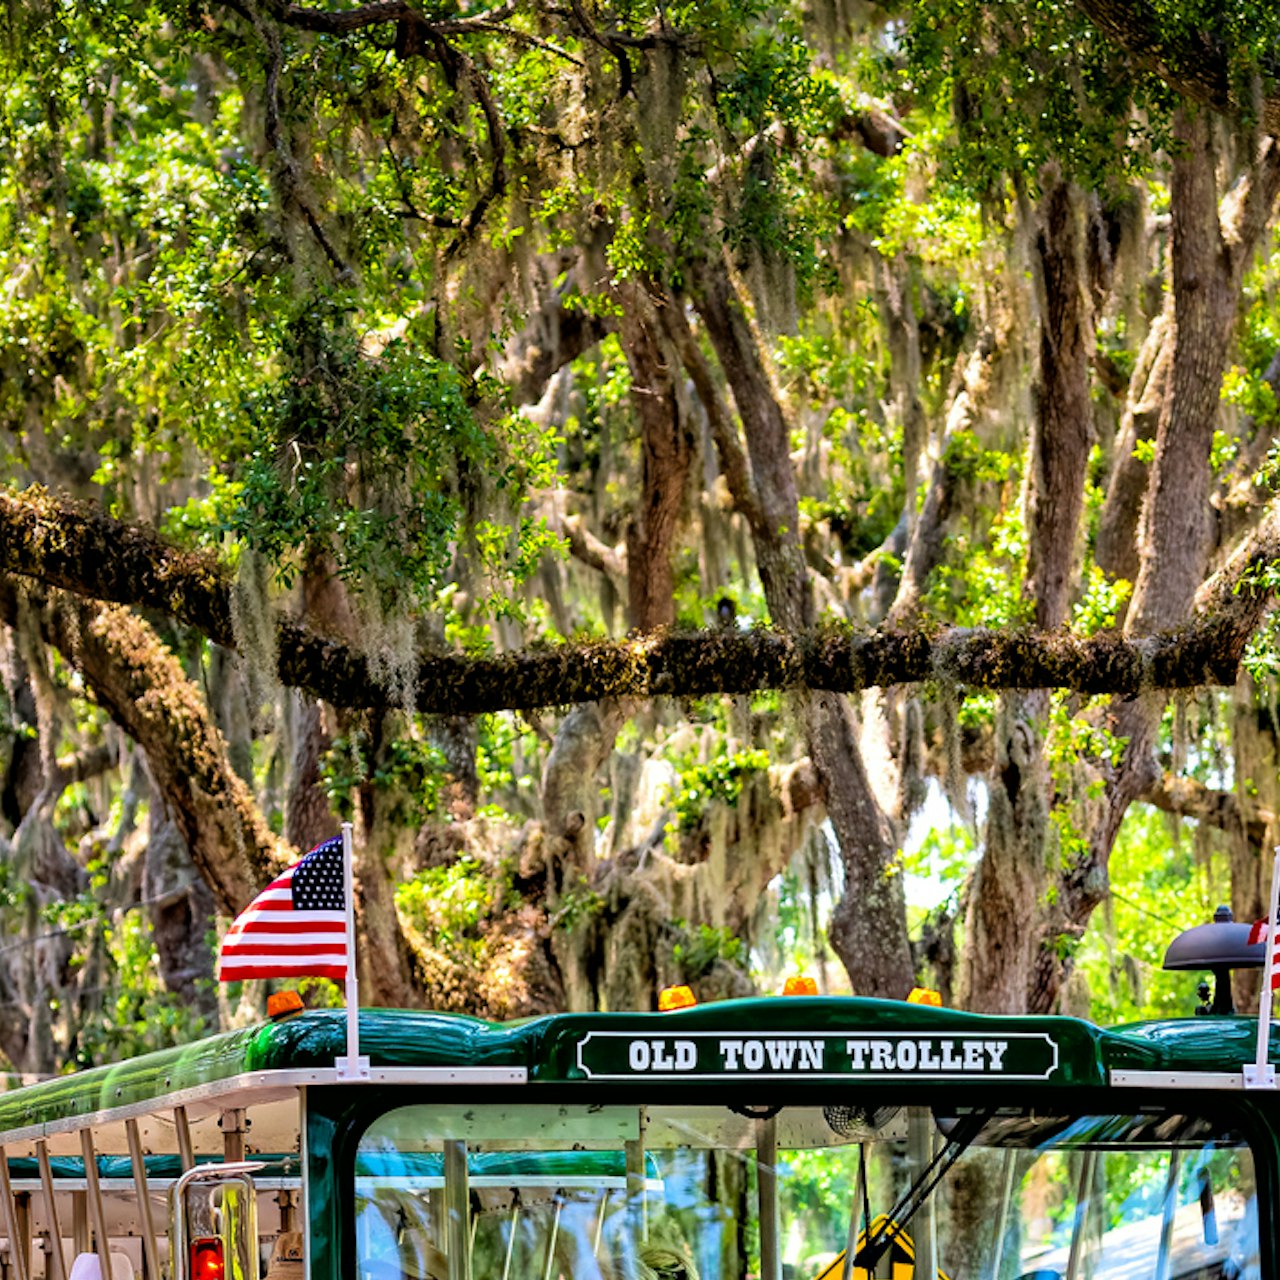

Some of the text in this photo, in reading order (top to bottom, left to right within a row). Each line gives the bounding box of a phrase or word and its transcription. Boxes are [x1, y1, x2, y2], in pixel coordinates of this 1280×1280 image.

[629, 1040, 1008, 1071] OLD TOWN TROLLEY
